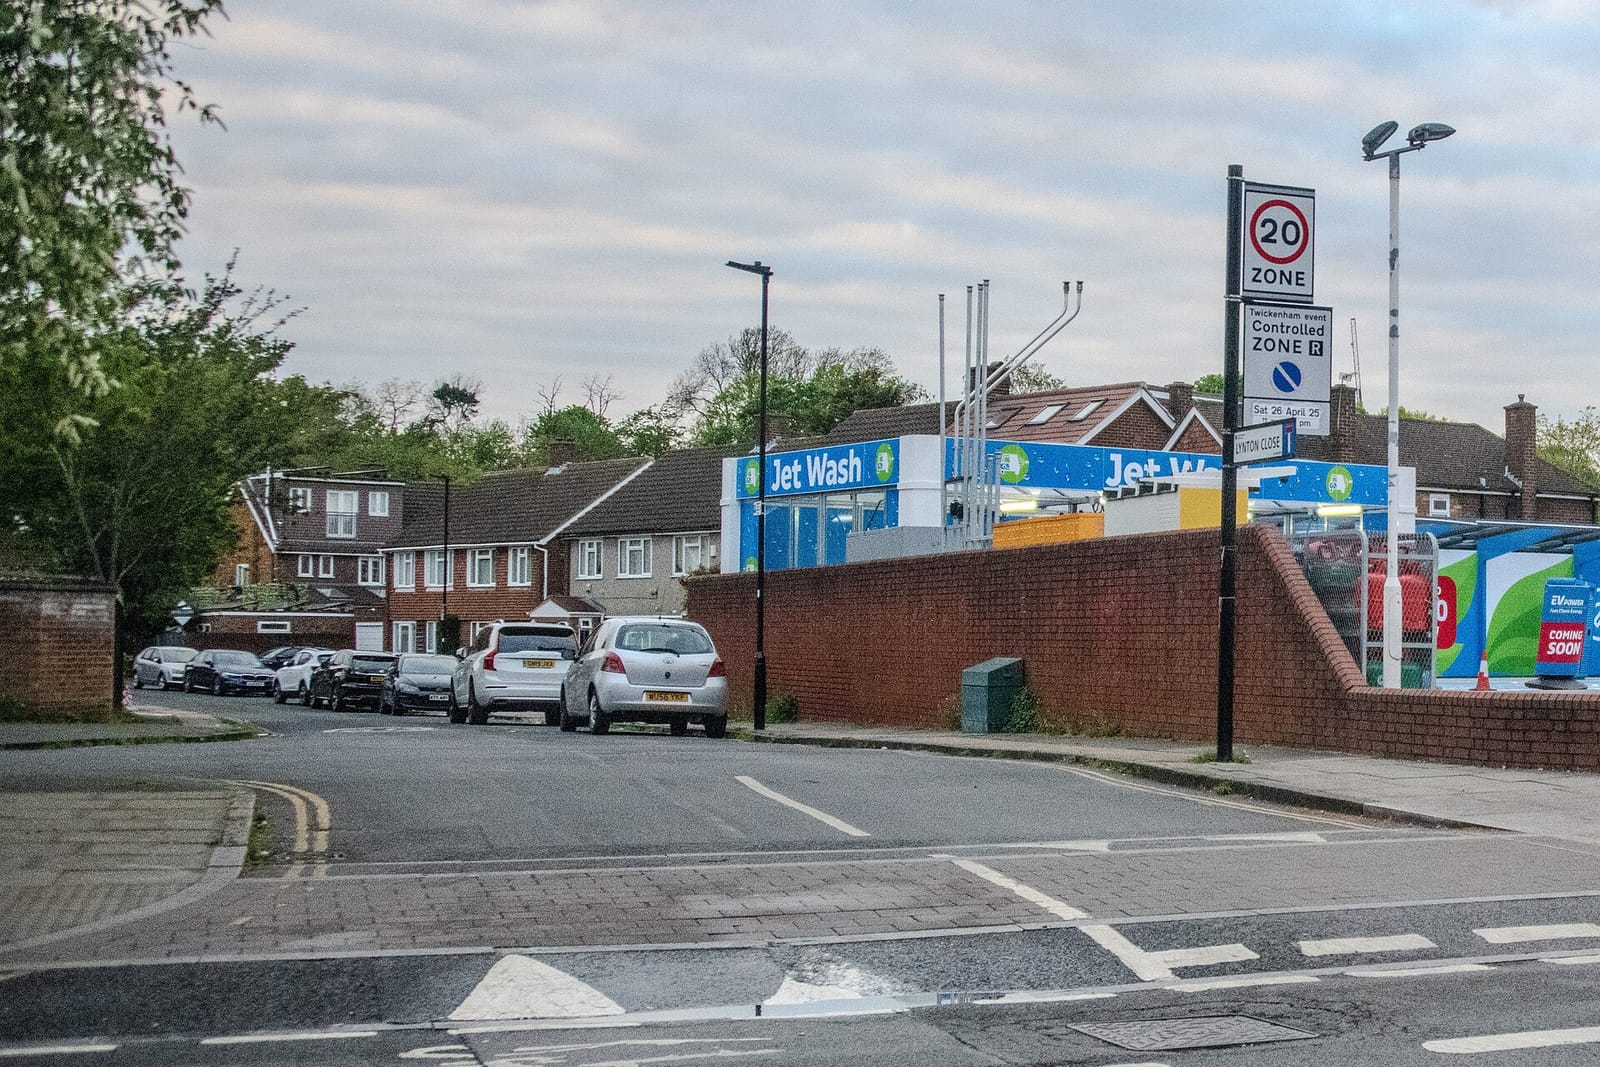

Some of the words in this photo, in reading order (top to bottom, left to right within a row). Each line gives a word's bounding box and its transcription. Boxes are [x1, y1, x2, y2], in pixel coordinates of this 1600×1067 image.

[1260, 218, 1301, 246] 20
[1251, 267, 1305, 287] ZONE
[1249, 308, 1301, 320] Twickenham
[1304, 312, 1327, 322] event
[1252, 320, 1325, 337] Controlled
[1252, 337, 1302, 354] ZONE
[1310, 340, 1322, 355] R
[1254, 405, 1268, 414] Sat
[1271, 406, 1282, 415] 26
[1285, 407, 1306, 418] April
[1308, 408, 1320, 418] 25
[1235, 439, 1259, 454] LYNTON
[1260, 435, 1280, 450] CLOSE
[771, 458, 802, 492] Jet
[806, 448, 862, 488] Wash
[1105, 453, 1160, 487] Jet
[1549, 630, 1584, 640] COMING
[1547, 642, 1581, 655] SOON
